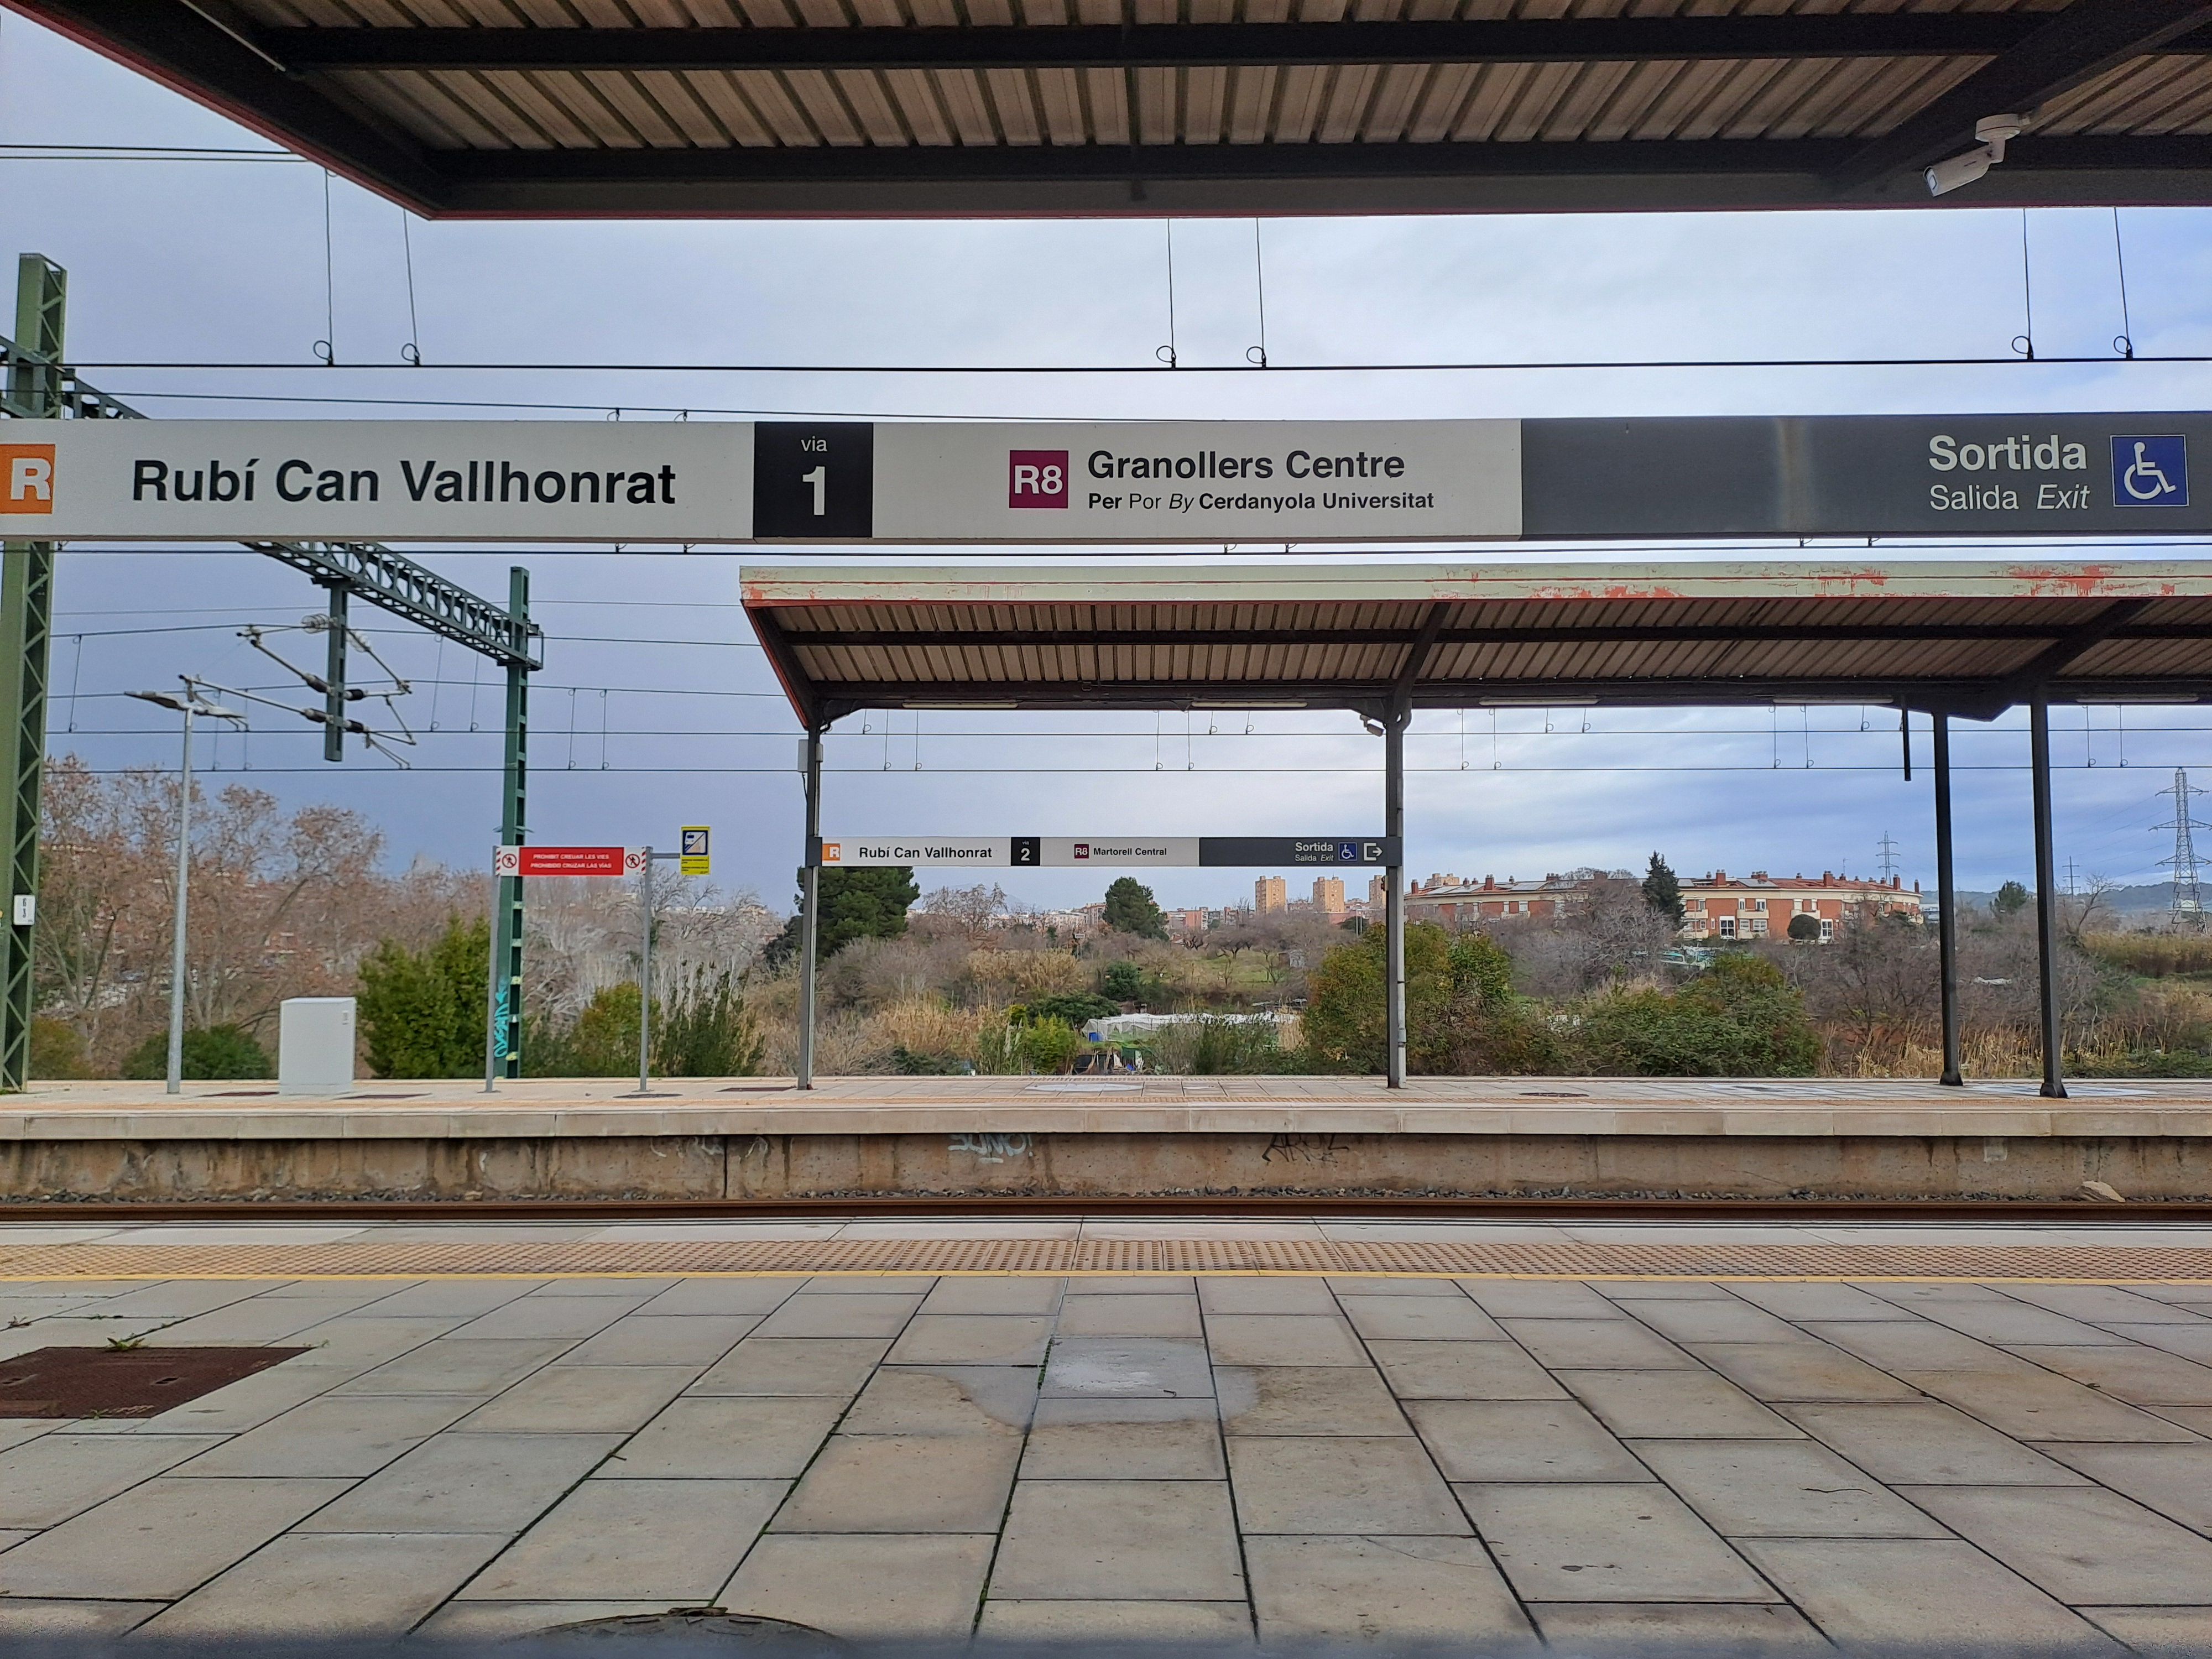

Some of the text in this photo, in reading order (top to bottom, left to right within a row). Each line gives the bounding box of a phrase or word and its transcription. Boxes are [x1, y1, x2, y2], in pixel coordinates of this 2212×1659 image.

[801, 435, 828, 452] via
[1929, 435, 2087, 471] Sortida
[1088, 450, 1405, 479] Granollers Centre
[11, 457, 52, 500] R
[133, 458, 676, 504] Rubí Can Vallhonrat
[802, 466, 826, 515] 1
[1014, 465, 1063, 494] R8
[1089, 492, 1434, 514] Per Por By Cerdanyola Universitat
[1930, 484, 2091, 510] Salida Exit
[859, 847, 993, 858] Rubí Can Vallhonrat
[1021, 848, 1030, 861] 2
[1075, 847, 1088, 856] R8
[1295, 842, 1333, 852] Sortida
